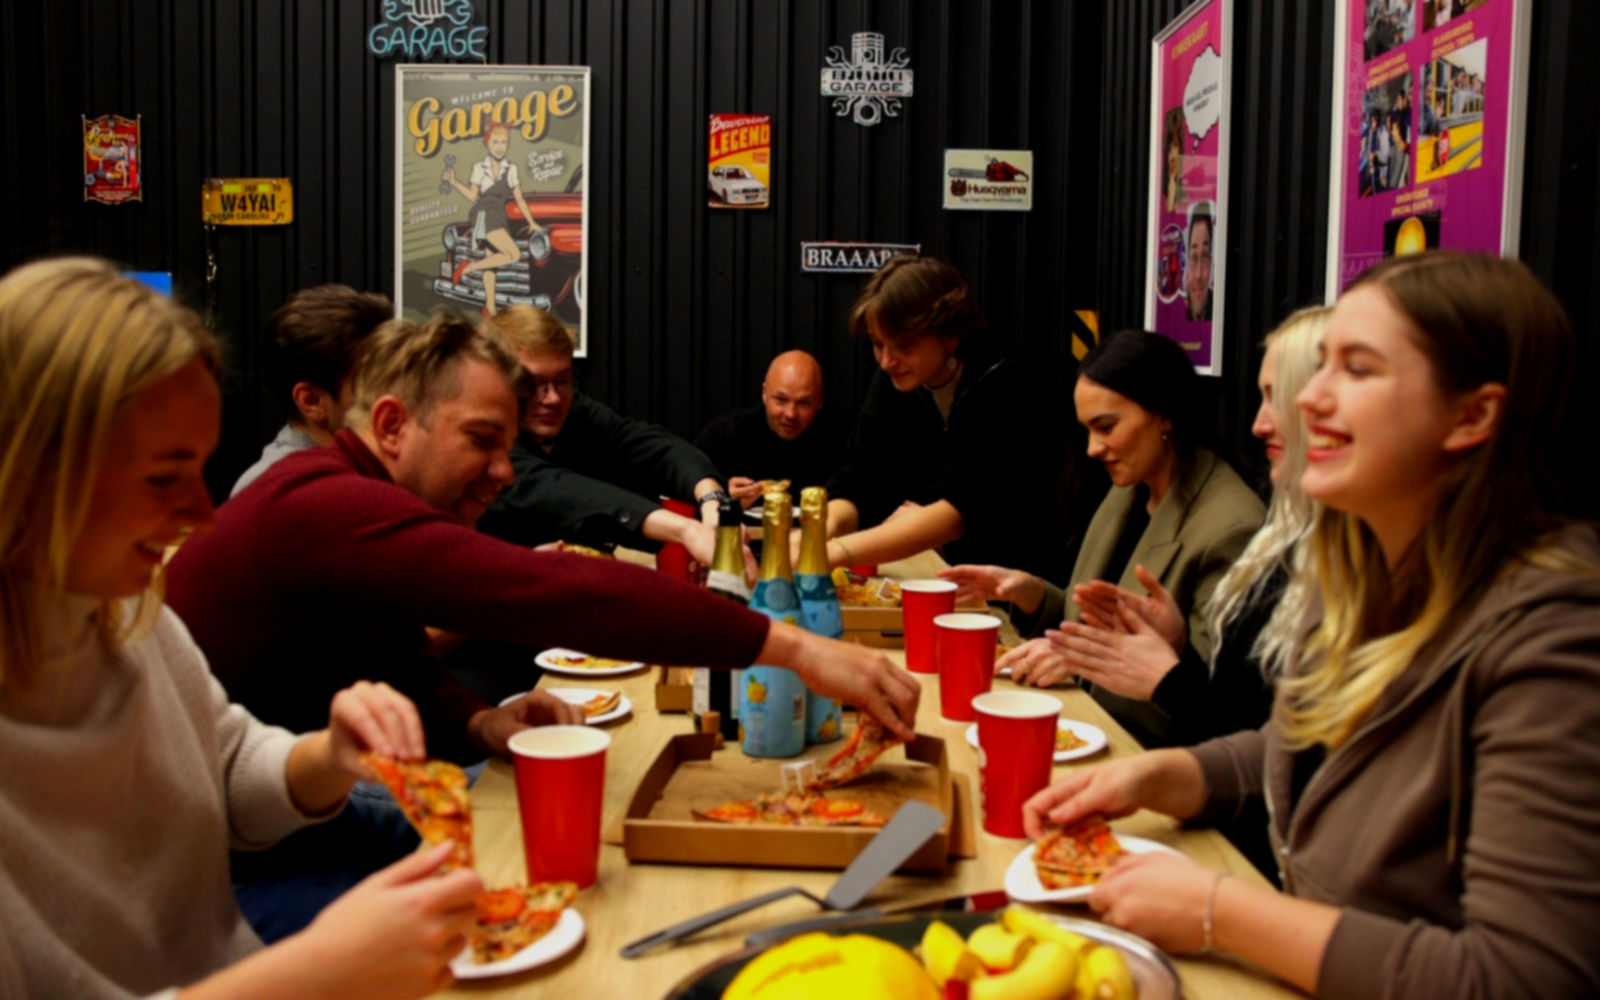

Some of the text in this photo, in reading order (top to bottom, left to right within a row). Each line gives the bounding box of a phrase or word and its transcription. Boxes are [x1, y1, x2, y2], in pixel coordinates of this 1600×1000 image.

[369, 24, 487, 56] GARAGE
[452, 86, 514, 105] WELCOME TO
[830, 82, 904, 93] GARAGE
[408, 85, 577, 157] Garage
[710, 115, 769, 135] Bavarian
[710, 124, 770, 159] LEGEND
[528, 149, 564, 167] Service
[531, 164, 564, 183] Repair
[968, 184, 1026, 196] Husqvarna
[220, 194, 276, 212] W4YAI
[410, 200, 441, 215] QUALITY
[236, 212, 270, 220] CAROLINA
[410, 205, 458, 224] GUARANTEED
[807, 248, 901, 267] BRAAAP
